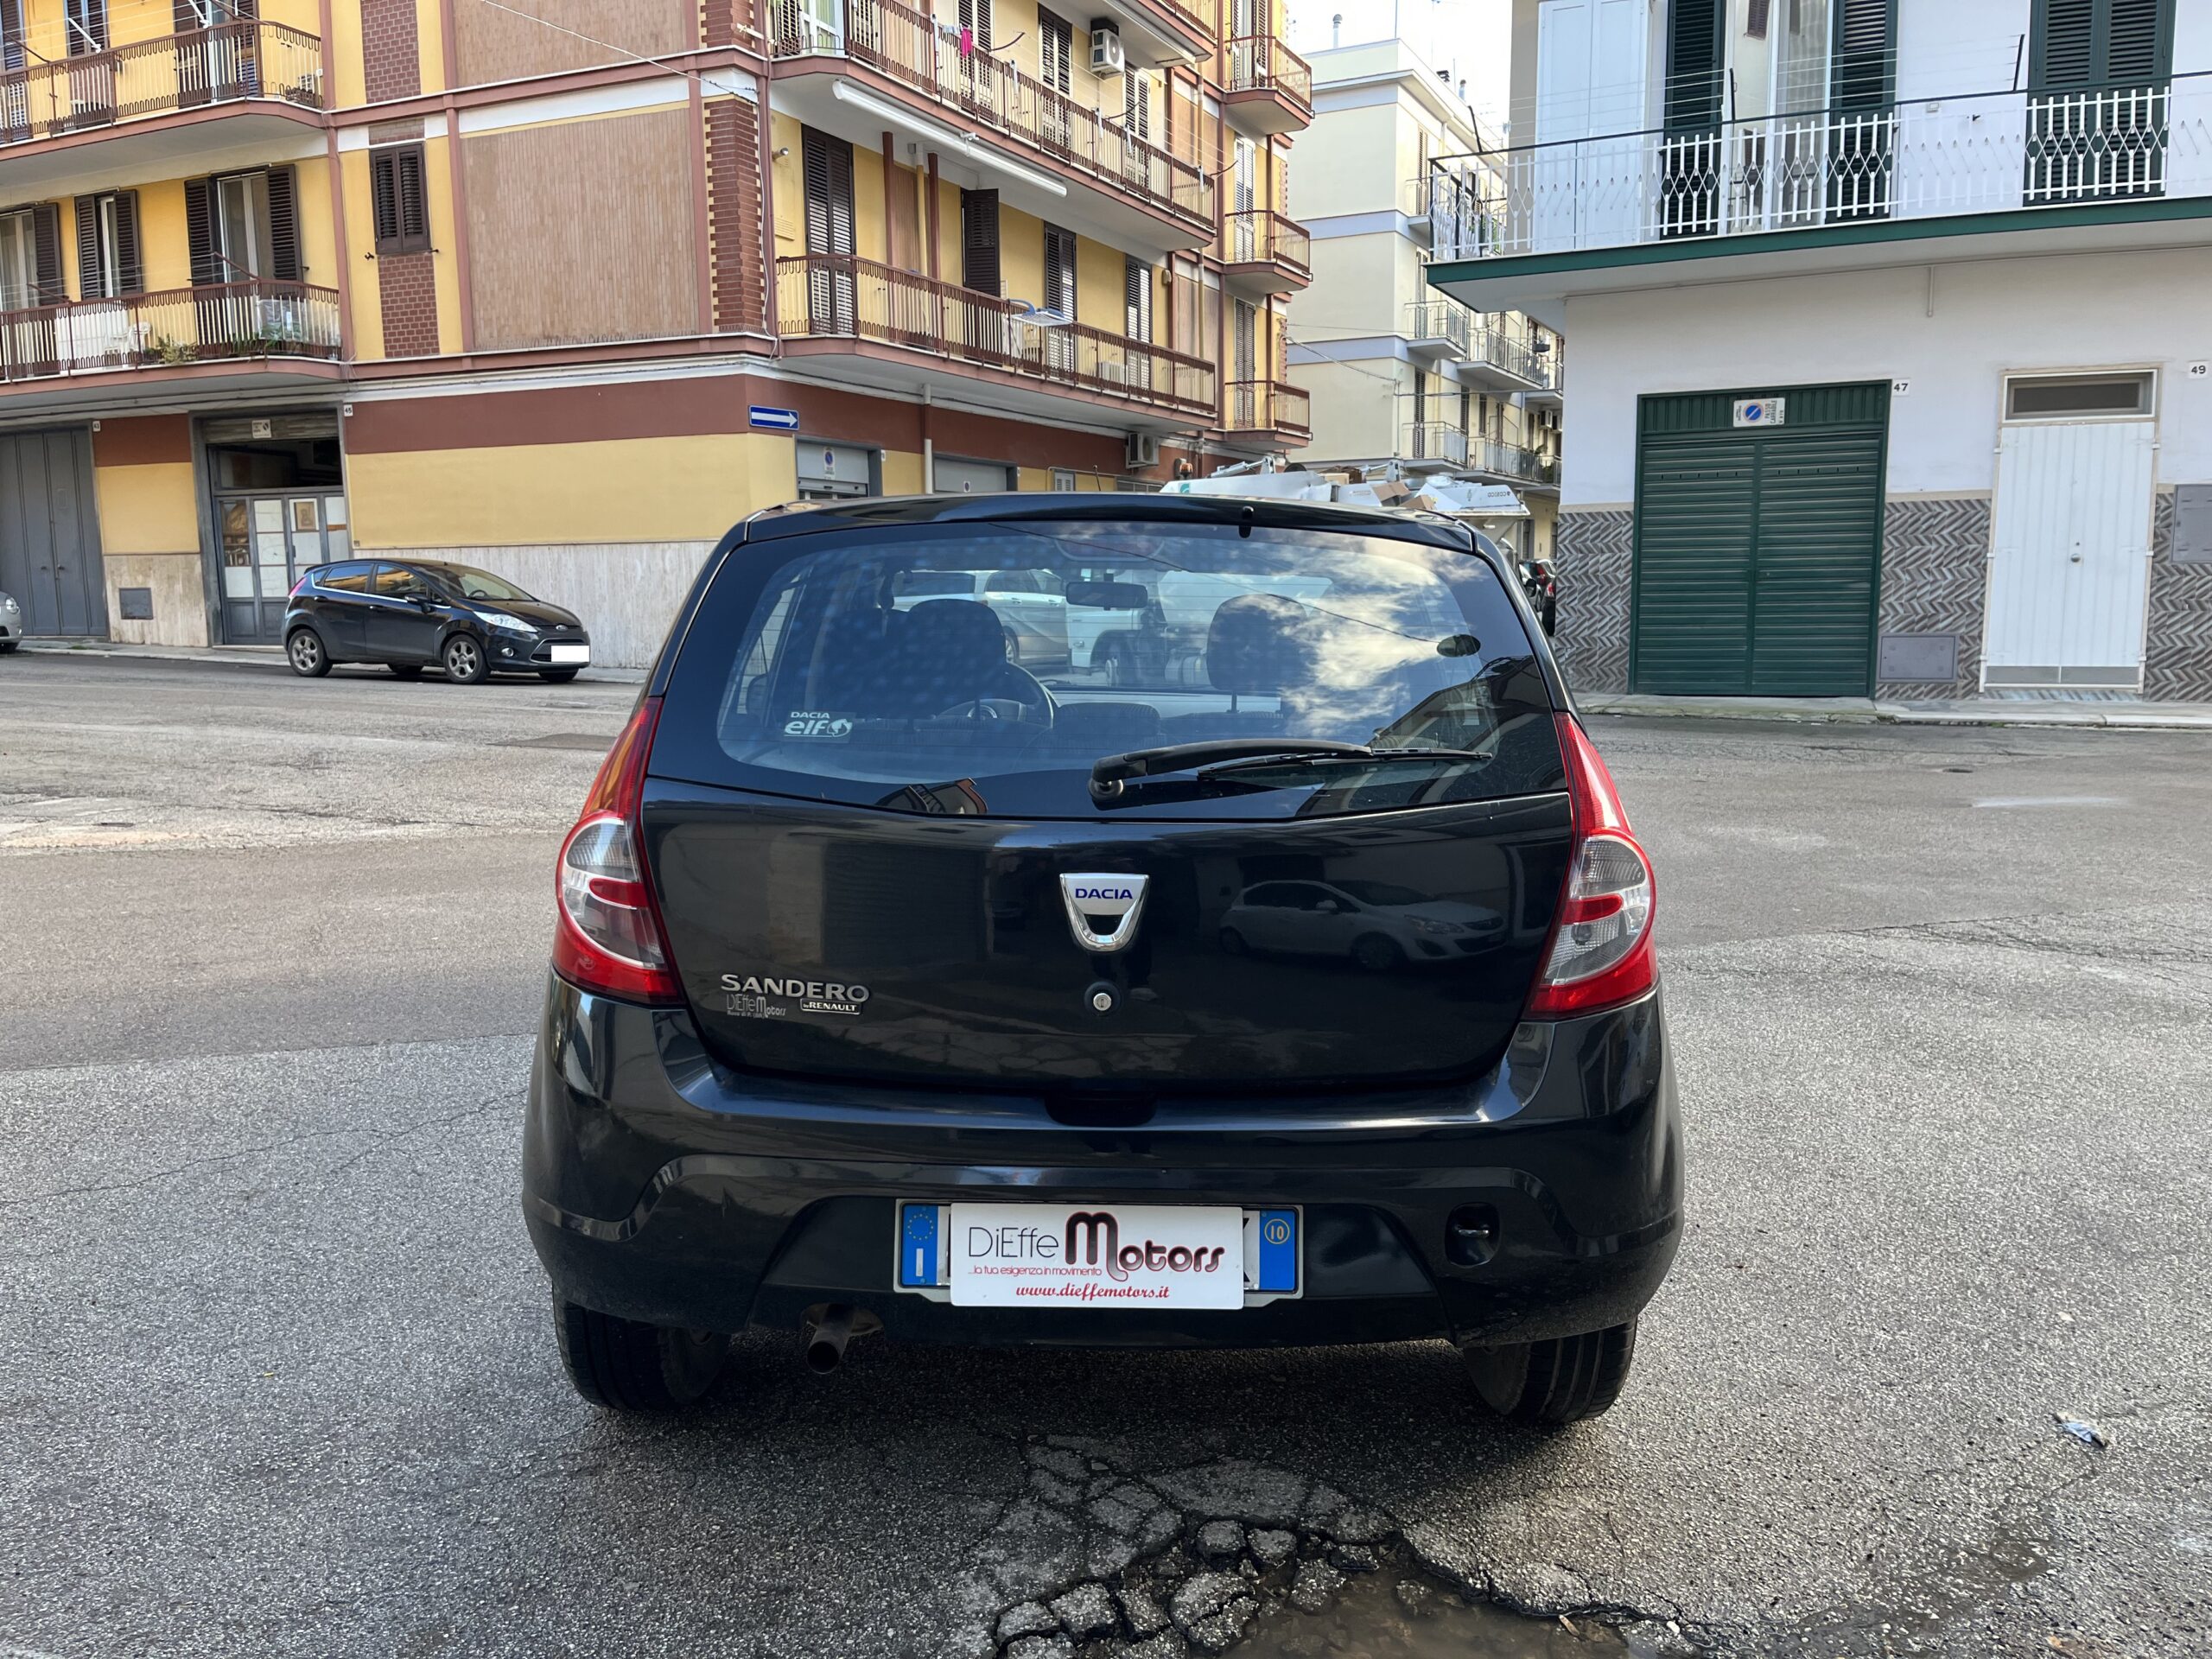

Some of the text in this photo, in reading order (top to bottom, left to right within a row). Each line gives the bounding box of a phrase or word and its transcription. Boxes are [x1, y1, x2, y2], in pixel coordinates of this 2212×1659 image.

[2190, 365, 2207, 374] 49
[1893, 383, 1909, 391] 47
[784, 720, 829, 734] elf
[1075, 888, 1133, 899] DACIA
[721, 974, 870, 1002] SANDERO
[809, 1001, 857, 1012] RENAULT
[1270, 1224, 1285, 1240] 10
[968, 1211, 1226, 1283] DiEffe Motors
[915, 1248, 924, 1277] I
[983, 1266, 999, 1274] tua
[1000, 1266, 1043, 1277] esigenza
[1052, 1266, 1103, 1276] movimento
[1015, 1282, 1170, 1301] www.dieffemotors.it
